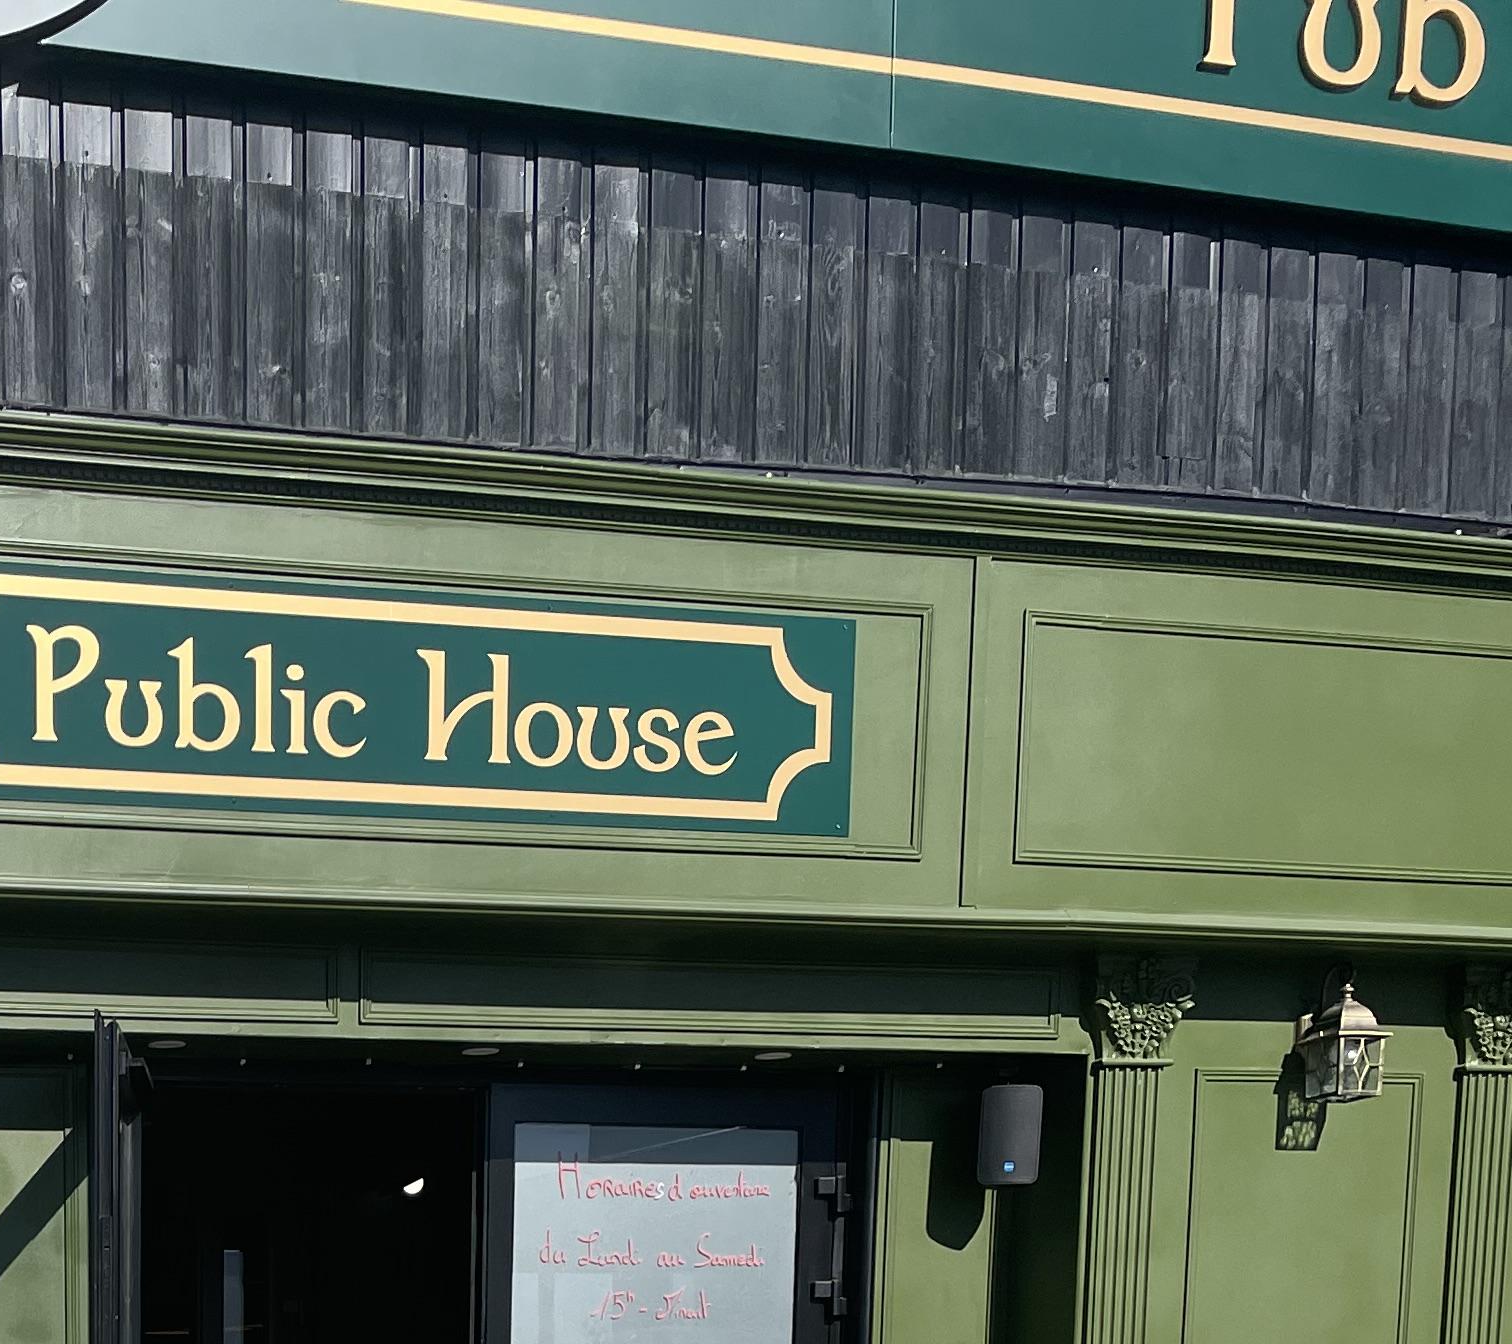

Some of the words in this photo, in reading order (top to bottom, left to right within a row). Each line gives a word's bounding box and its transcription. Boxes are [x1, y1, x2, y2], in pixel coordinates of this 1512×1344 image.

[25, 623, 368, 759] Public
[415, 647, 739, 779] House
[557, 1150, 665, 1200] Horaires
[539, 1228, 566, 1265] du
[656, 1252, 686, 1268] au
